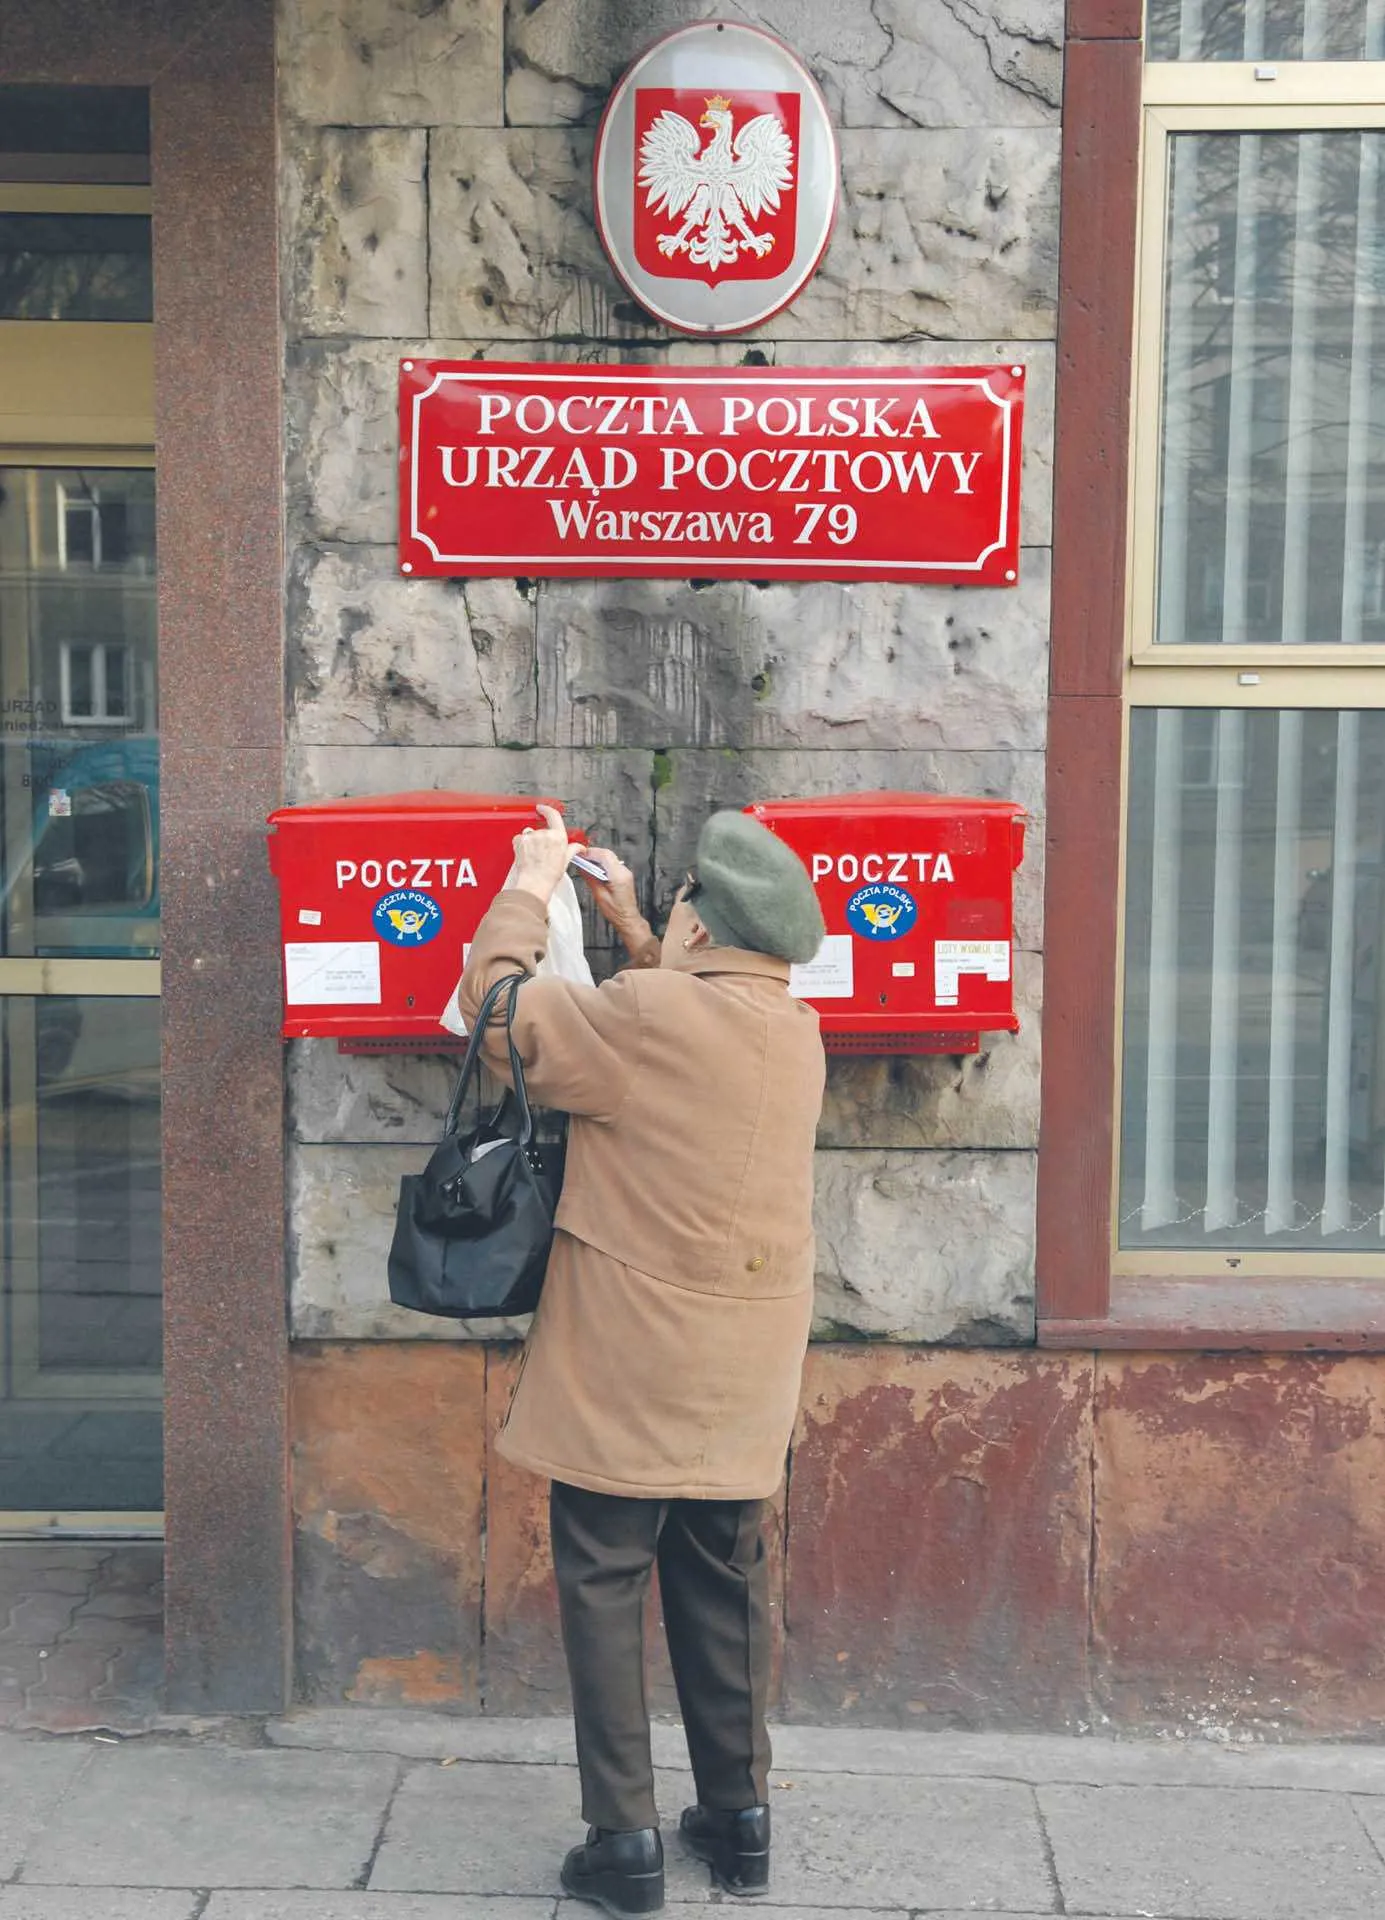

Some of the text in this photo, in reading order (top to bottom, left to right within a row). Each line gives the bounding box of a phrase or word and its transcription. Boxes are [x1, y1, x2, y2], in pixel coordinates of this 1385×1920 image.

[477, 394, 941, 438] POCZTA POLSKA
[438, 446, 983, 497] URZĄD POCZTOWY
[546, 499, 859, 545] Warszawa 79
[335, 858, 478, 889] POCZTA
[812, 852, 955, 884] POCZTA
[376, 891, 439, 919] POCZTA POLSKA
[849, 886, 913, 912] POCZTA POLSKA
